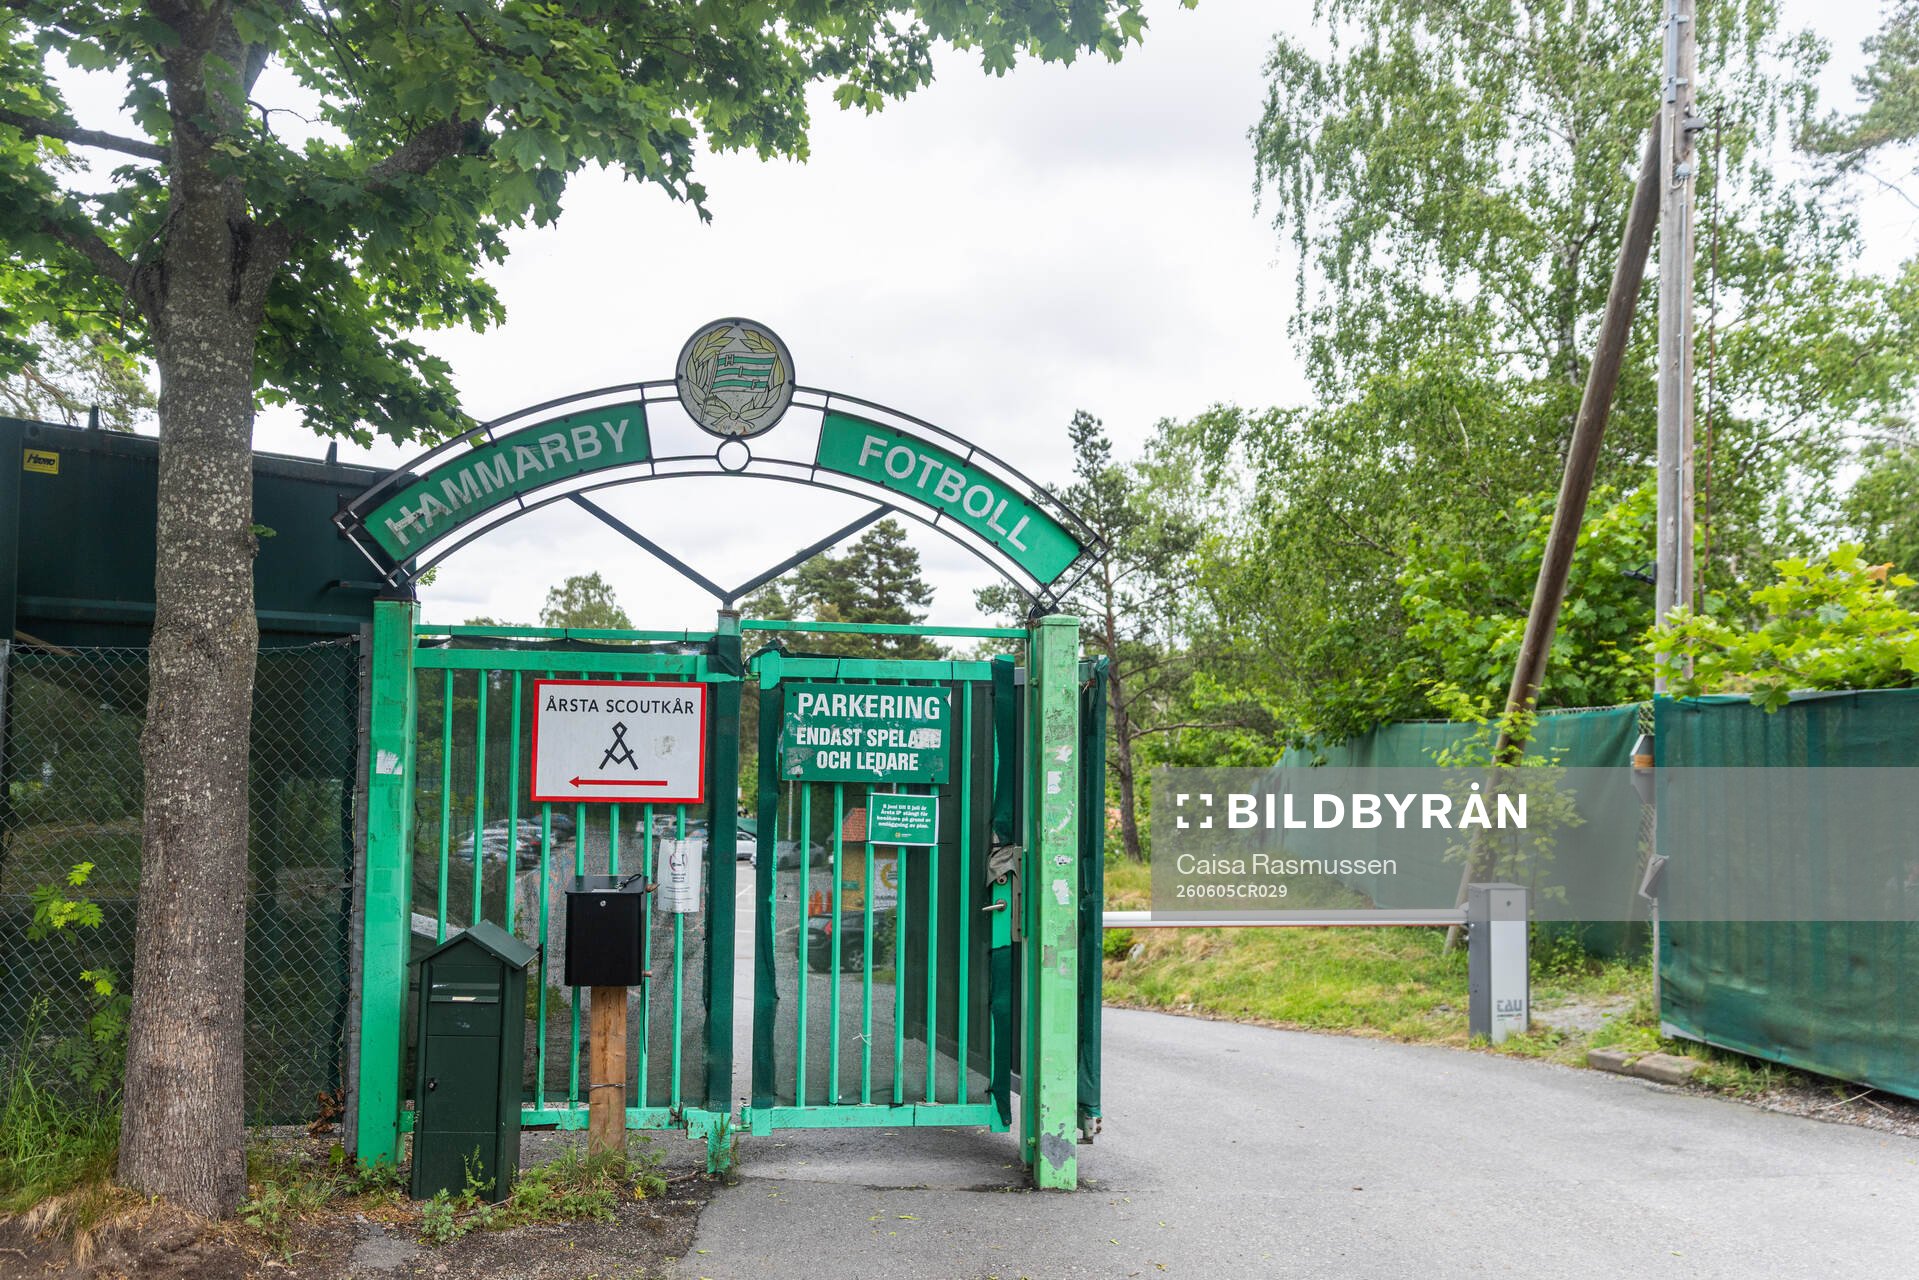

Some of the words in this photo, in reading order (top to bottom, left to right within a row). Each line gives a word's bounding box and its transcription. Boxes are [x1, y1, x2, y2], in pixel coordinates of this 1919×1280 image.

[384, 418, 630, 547] HAMMARBY
[857, 434, 1030, 553] FOTBOLL
[545, 695, 600, 713] ÅRSTA
[606, 697, 695, 715] SCOUTKÅR
[797, 692, 941, 721] PARKERING
[796, 726, 863, 747] ENDAST
[816, 751, 851, 770] OCH
[856, 752, 920, 772] LEDARE
